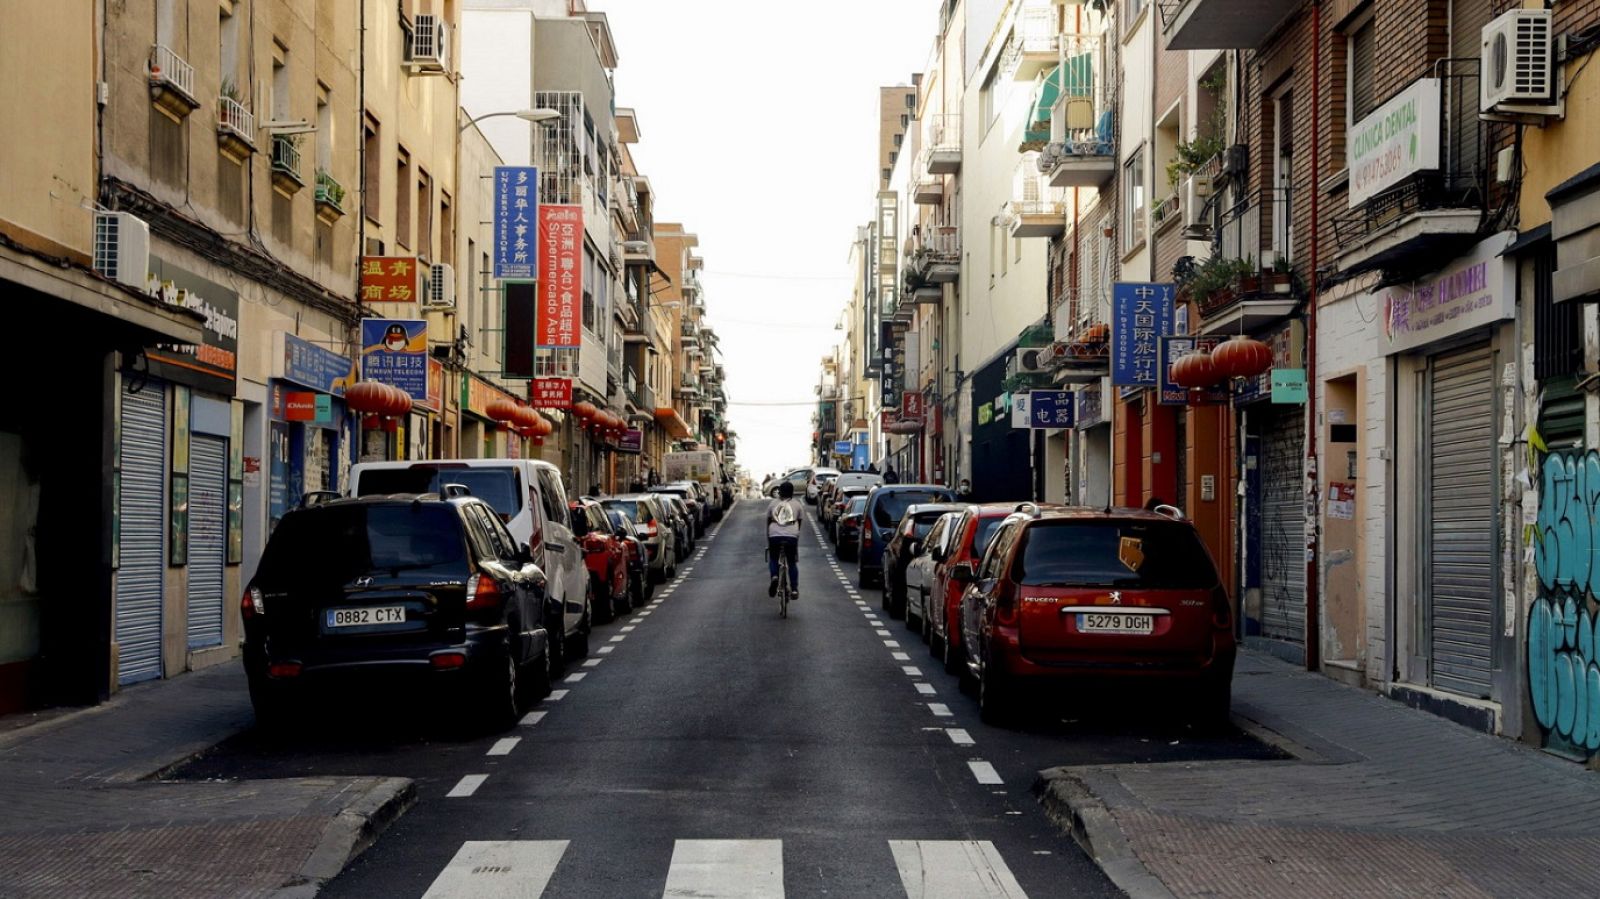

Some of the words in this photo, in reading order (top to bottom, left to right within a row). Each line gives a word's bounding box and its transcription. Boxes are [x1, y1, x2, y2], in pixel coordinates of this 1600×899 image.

[1384, 98, 1417, 141] DENTAL
[500, 171, 509, 217] UNIVERSO
[500, 219, 508, 263] ASESORIA
[547, 222, 559, 315] Supermercado
[362, 284, 412, 301] 商场
[1120, 298, 1128, 315] TEL
[547, 318, 558, 345] Asia
[1133, 286, 1156, 382] 中天国际旅行社
[393, 368, 425, 376] TELECOM
[1036, 391, 1069, 406] 一品
[1036, 408, 1069, 423] 电器
[335, 611, 370, 624] 0882
[375, 608, 402, 622] CTX
[1087, 615, 1120, 628] 5279
[1125, 615, 1150, 629] DGH
